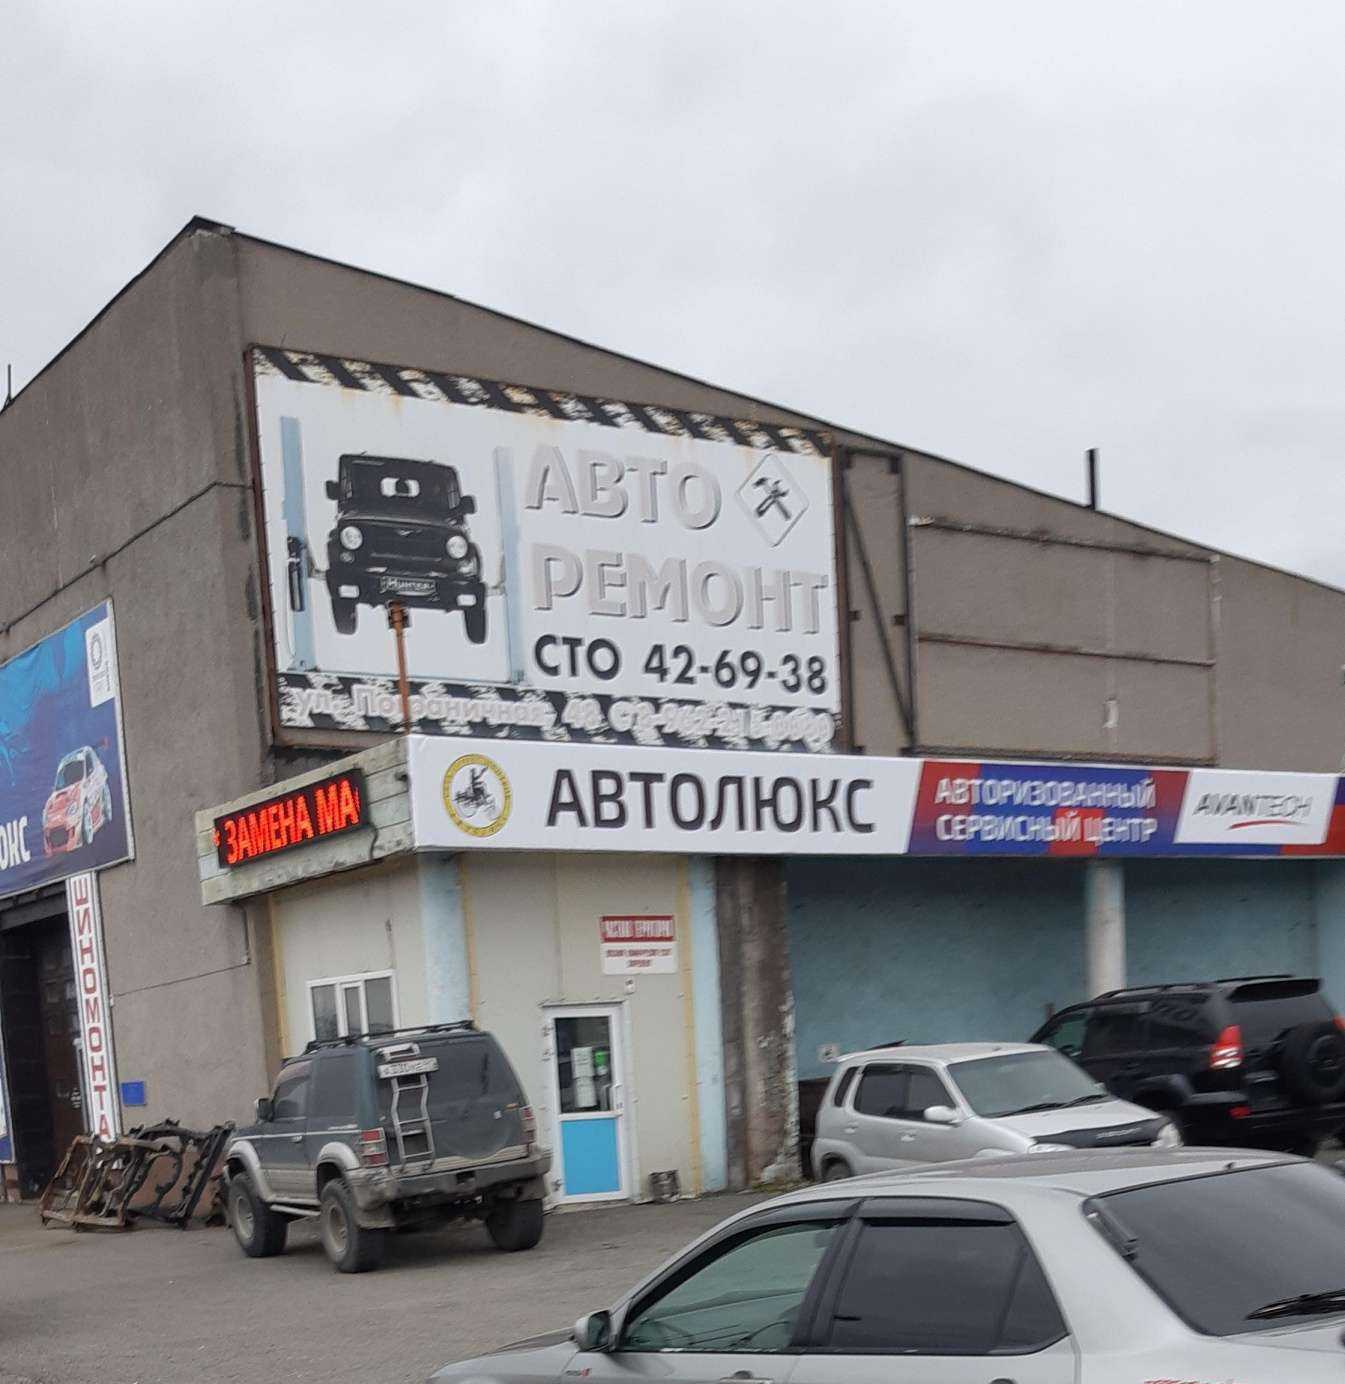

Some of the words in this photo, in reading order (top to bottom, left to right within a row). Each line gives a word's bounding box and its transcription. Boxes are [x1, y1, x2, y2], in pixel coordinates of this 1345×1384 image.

[523, 444, 722, 530] АВТО
[532, 542, 828, 635] РЕМОНТ
[534, 634, 622, 681] СТО
[643, 644, 828, 695] 42-69-38
[223, 795, 314, 865] ЗАМЕНА
[314, 779, 360, 835] МА
[546, 768, 876, 834] АВТОЛЮКС
[934, 777, 1158, 809] АВТОРИЗОВАННЫЙ
[1191, 792, 1313, 818] AVANTECH
[936, 811, 1081, 842] СЕРВИСНЫЙ
[1083, 816, 1158, 847] ЦЕНТР
[70, 877, 112, 1141] ШИНОМОНТА
